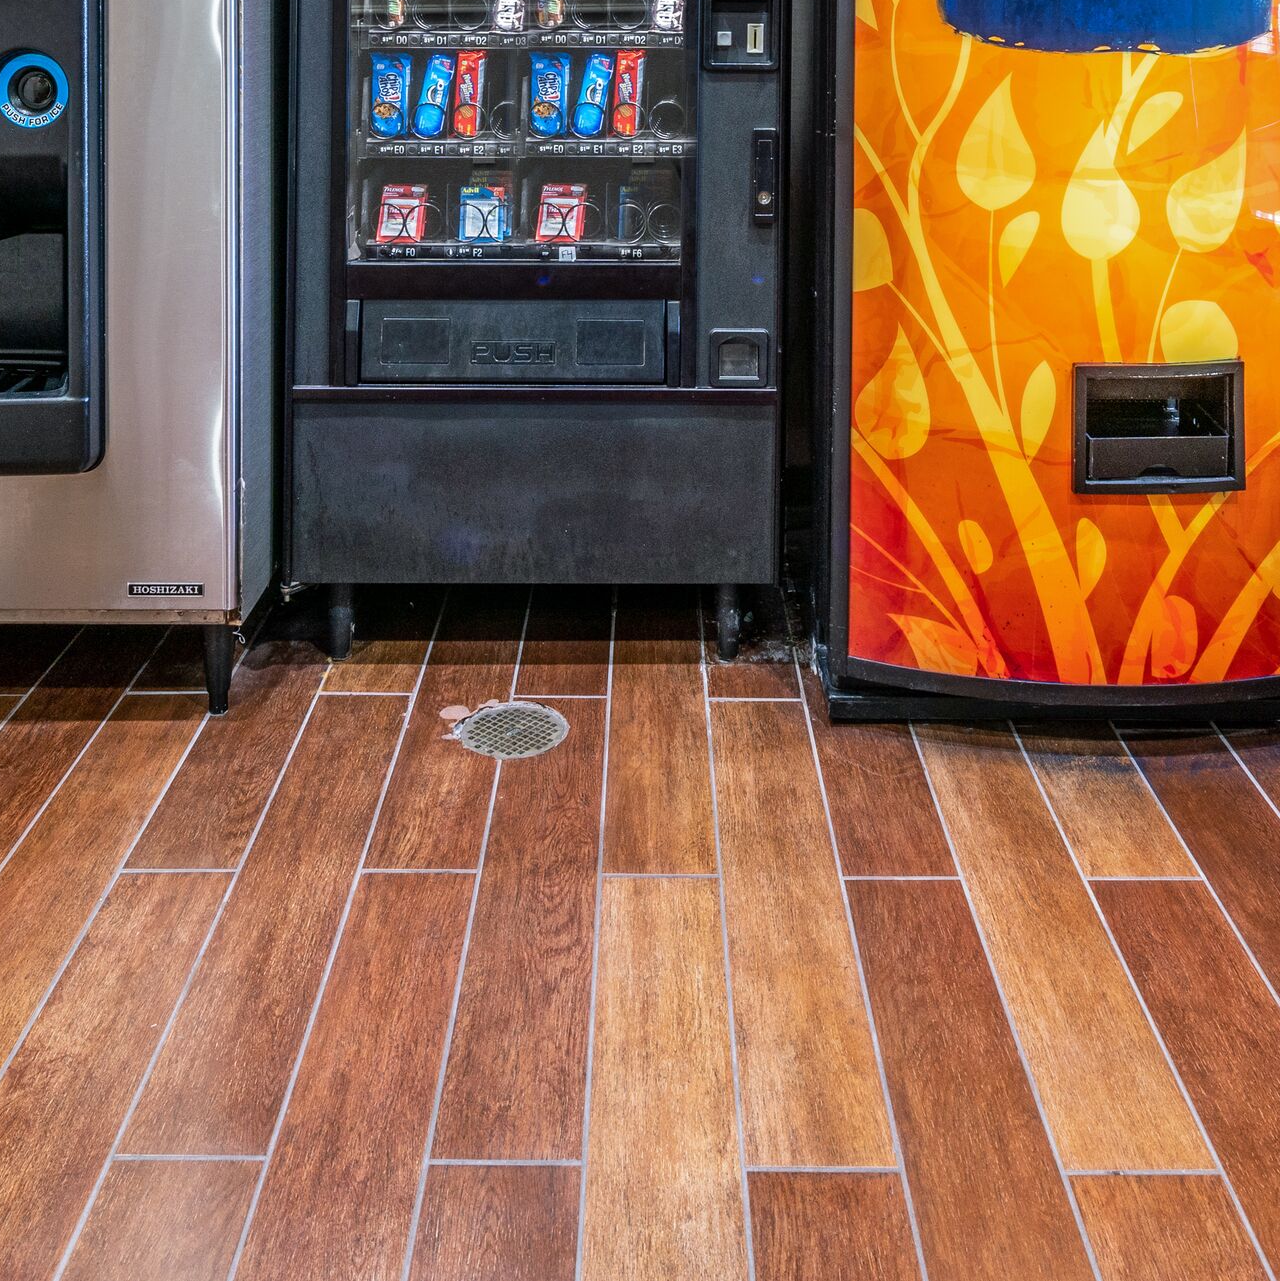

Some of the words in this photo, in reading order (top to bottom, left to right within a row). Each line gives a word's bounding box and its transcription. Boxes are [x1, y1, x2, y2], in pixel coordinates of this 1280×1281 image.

[396, 36, 408, 45] D0
[436, 36, 447, 45] D1
[476, 36, 487, 45] D2
[515, 37, 526, 46] D3
[555, 35, 567, 44] D0
[595, 35, 606, 44] D1
[634, 35, 646, 44] D2
[385, 73, 400, 95] Chips
[545, 72, 559, 94] Chips
[1, 102, 26, 125] PUSH
[28, 115, 49, 126] FOR
[50, 102, 64, 118] ICE
[394, 145, 405, 154] E0
[434, 145, 445, 154] E1
[473, 145, 484, 154] E2
[553, 144, 564, 153] E0
[593, 144, 604, 153] E1
[632, 144, 643, 154] E2
[672, 144, 683, 154] E3
[543, 185, 564, 193] TYLENOL
[405, 248, 415, 257] F0
[472, 248, 483, 257] F2
[632, 248, 642, 258] F6
[471, 343, 555, 363] PUSH
[132, 585, 199, 594] HOSHIZAKI
